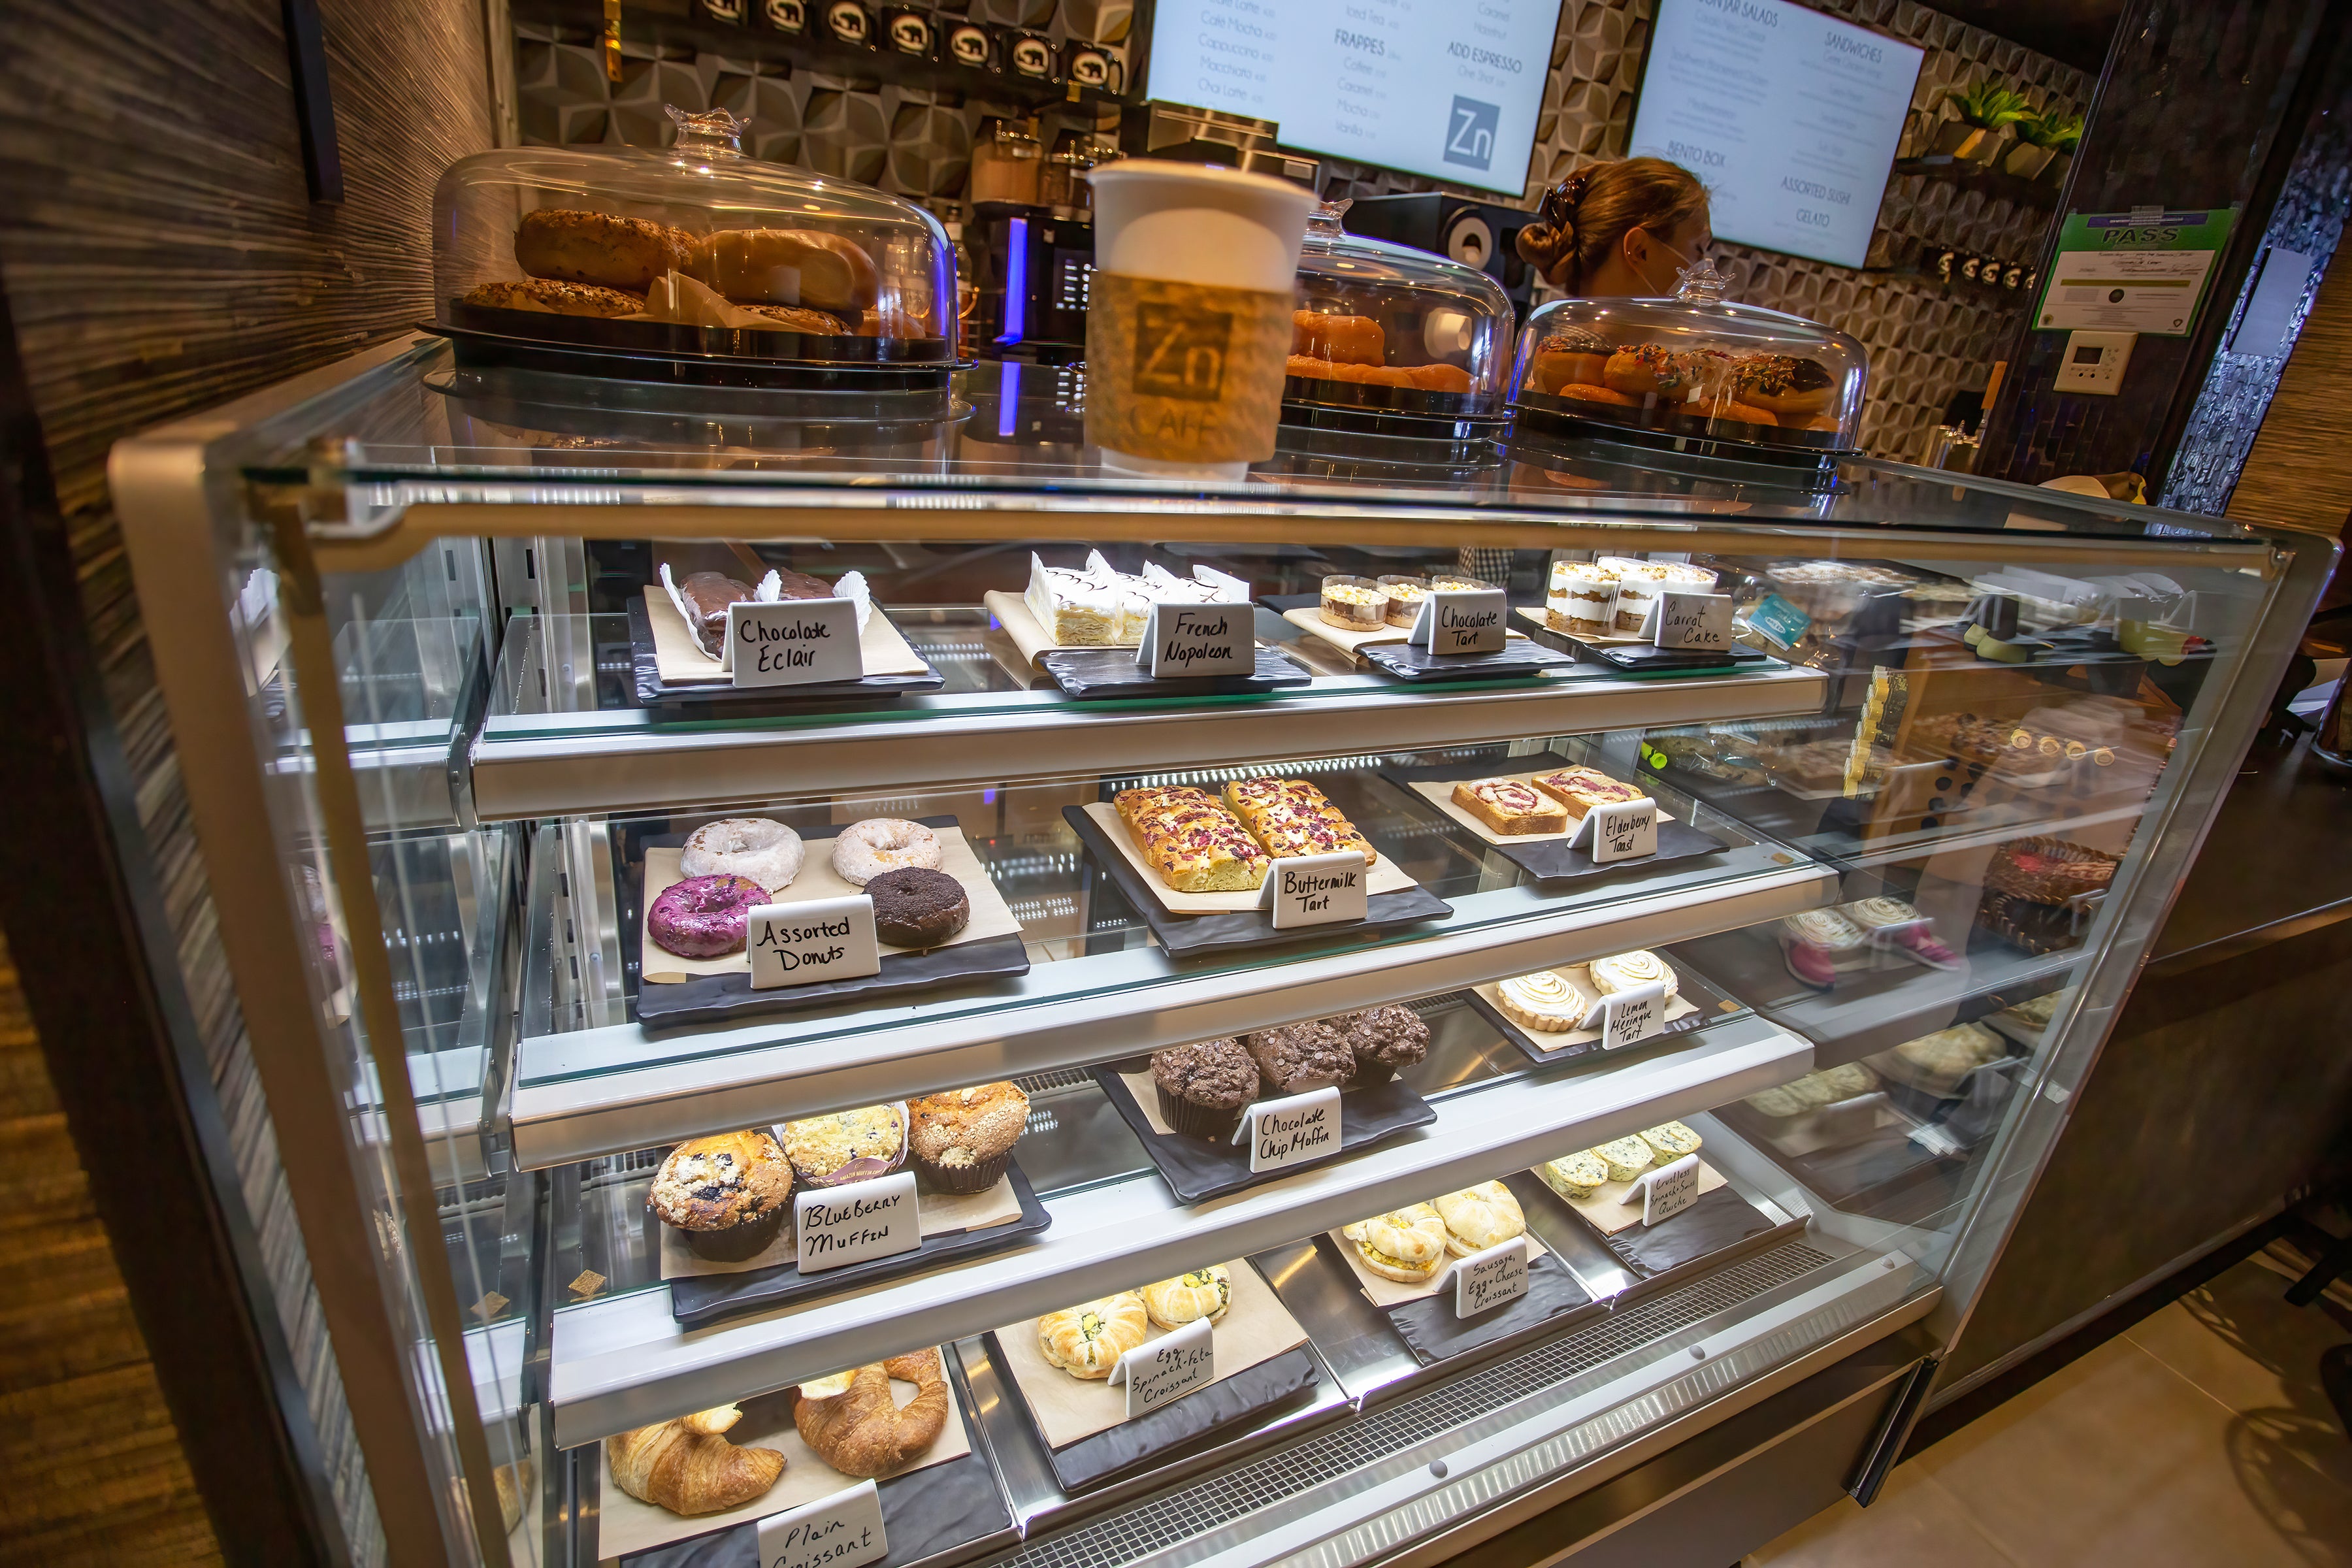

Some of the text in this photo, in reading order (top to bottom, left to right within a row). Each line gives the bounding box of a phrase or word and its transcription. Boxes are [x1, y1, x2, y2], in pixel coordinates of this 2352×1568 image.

[1740, 1, 1778, 27] SALADS
[1334, 28, 1385, 56] FRAPPES
[1825, 31, 1882, 63] SANDWICHES
[1446, 41, 1522, 74] ADD ESPRESSO
[1448, 107, 1492, 160] Zn
[1667, 140, 1727, 167] BENTO BOX
[1781, 176, 1827, 199] ASSORTED
[1796, 208, 1829, 227] GELATO
[2102, 228, 2180, 244] PASS
[1139, 318, 1222, 391] Zn
[1175, 612, 1228, 637] French
[1442, 605, 1497, 628] Chocolate
[1666, 600, 1706, 627] Carrot
[740, 619, 830, 644] Chocolate
[1451, 630, 1478, 646] Tart
[1684, 627, 1720, 644] Cake
[758, 644, 816, 672] Eclair
[1609, 834, 1635, 853] Toast
[1284, 871, 1357, 894] Buttermilk
[1295, 893, 1330, 913] Tart
[756, 916, 851, 947] Assorted
[772, 945, 845, 971] Donuts
[1610, 1010, 1652, 1033] Meringue
[1621, 1000, 1648, 1019] Lemon
[1620, 1024, 1642, 1043] Tart
[1262, 1107, 1325, 1135] Chocolate
[1260, 1139, 1288, 1160] Chip
[1656, 1168, 1690, 1190] Crustless
[1659, 1196, 1687, 1215] Quiche
[1474, 1282, 1517, 1309] Croissant
[1144, 1367, 1198, 1403] Croissant
[785, 1520, 845, 1548] Plain
